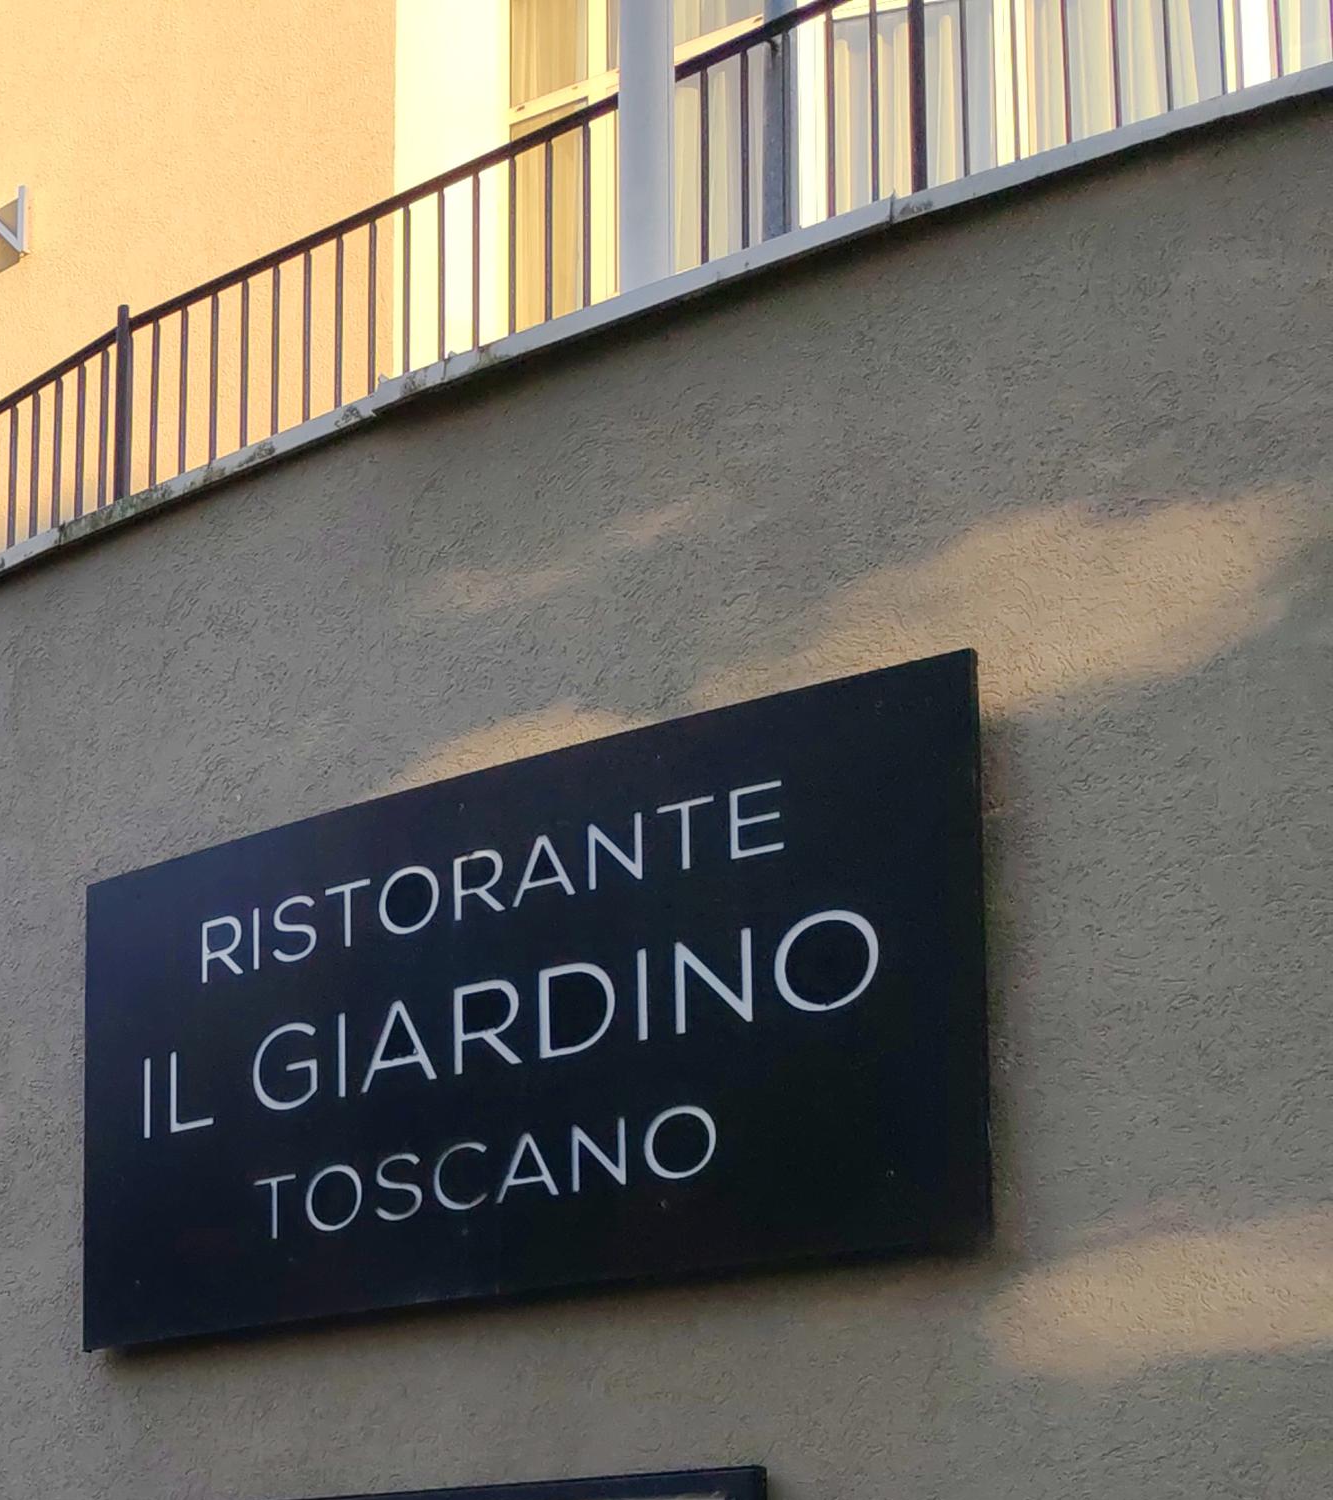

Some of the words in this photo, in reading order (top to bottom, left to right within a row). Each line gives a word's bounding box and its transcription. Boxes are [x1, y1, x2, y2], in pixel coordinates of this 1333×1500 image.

[200, 780, 786, 984] RISTORANTE
[141, 1050, 215, 1140] IL
[251, 908, 881, 1112] GIARDINO
[253, 1104, 718, 1240] TOSCANO
